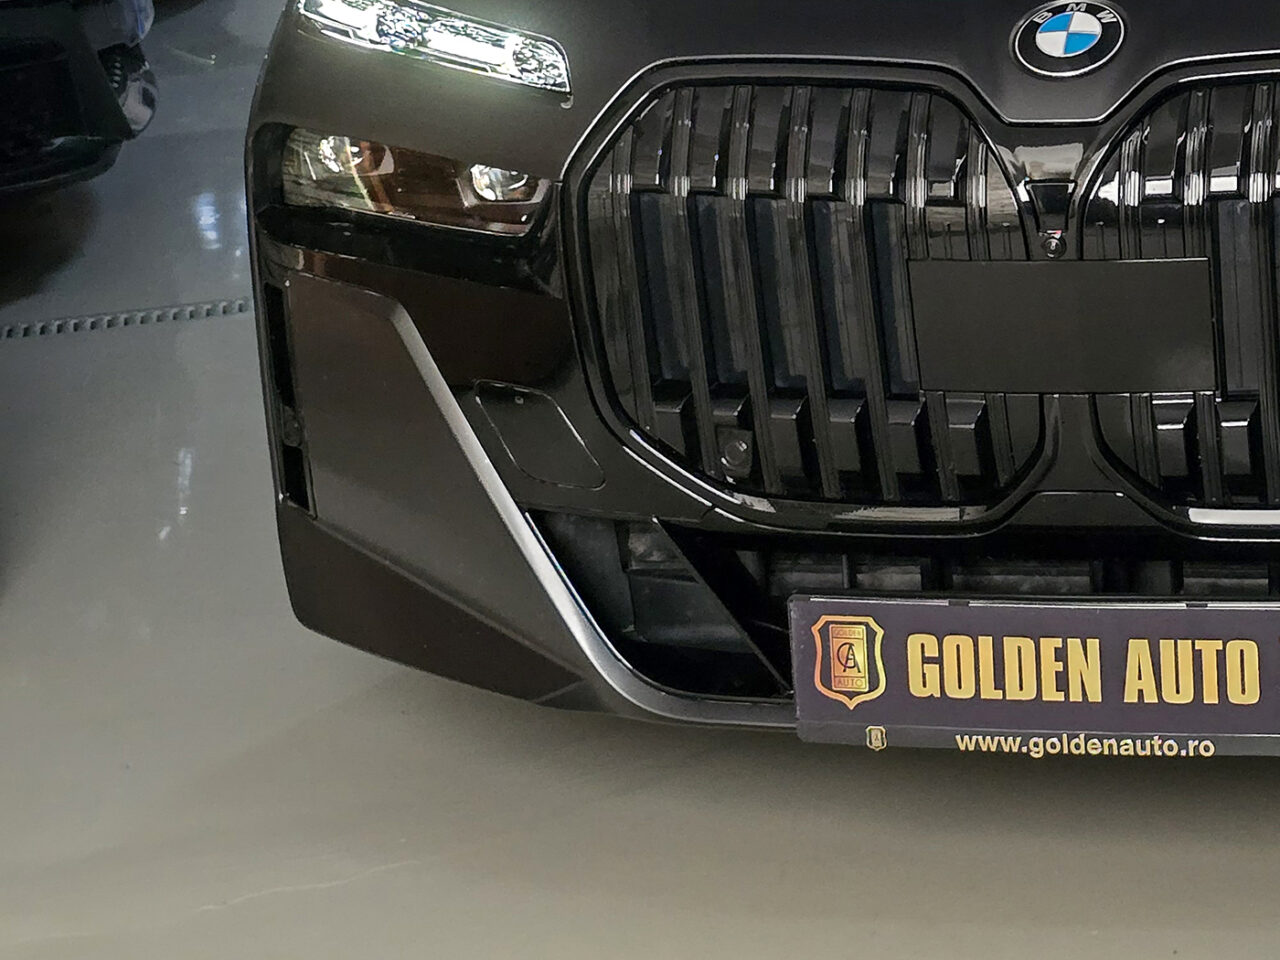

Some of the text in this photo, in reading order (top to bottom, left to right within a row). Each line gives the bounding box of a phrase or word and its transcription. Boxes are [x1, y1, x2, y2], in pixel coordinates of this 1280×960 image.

[1032, 2, 1118, 24] BMW
[906, 632, 1261, 705] GOLDEN AUTO
[836, 678, 864, 688] AUTO
[954, 732, 1216, 759] www.goldenauto.ro
